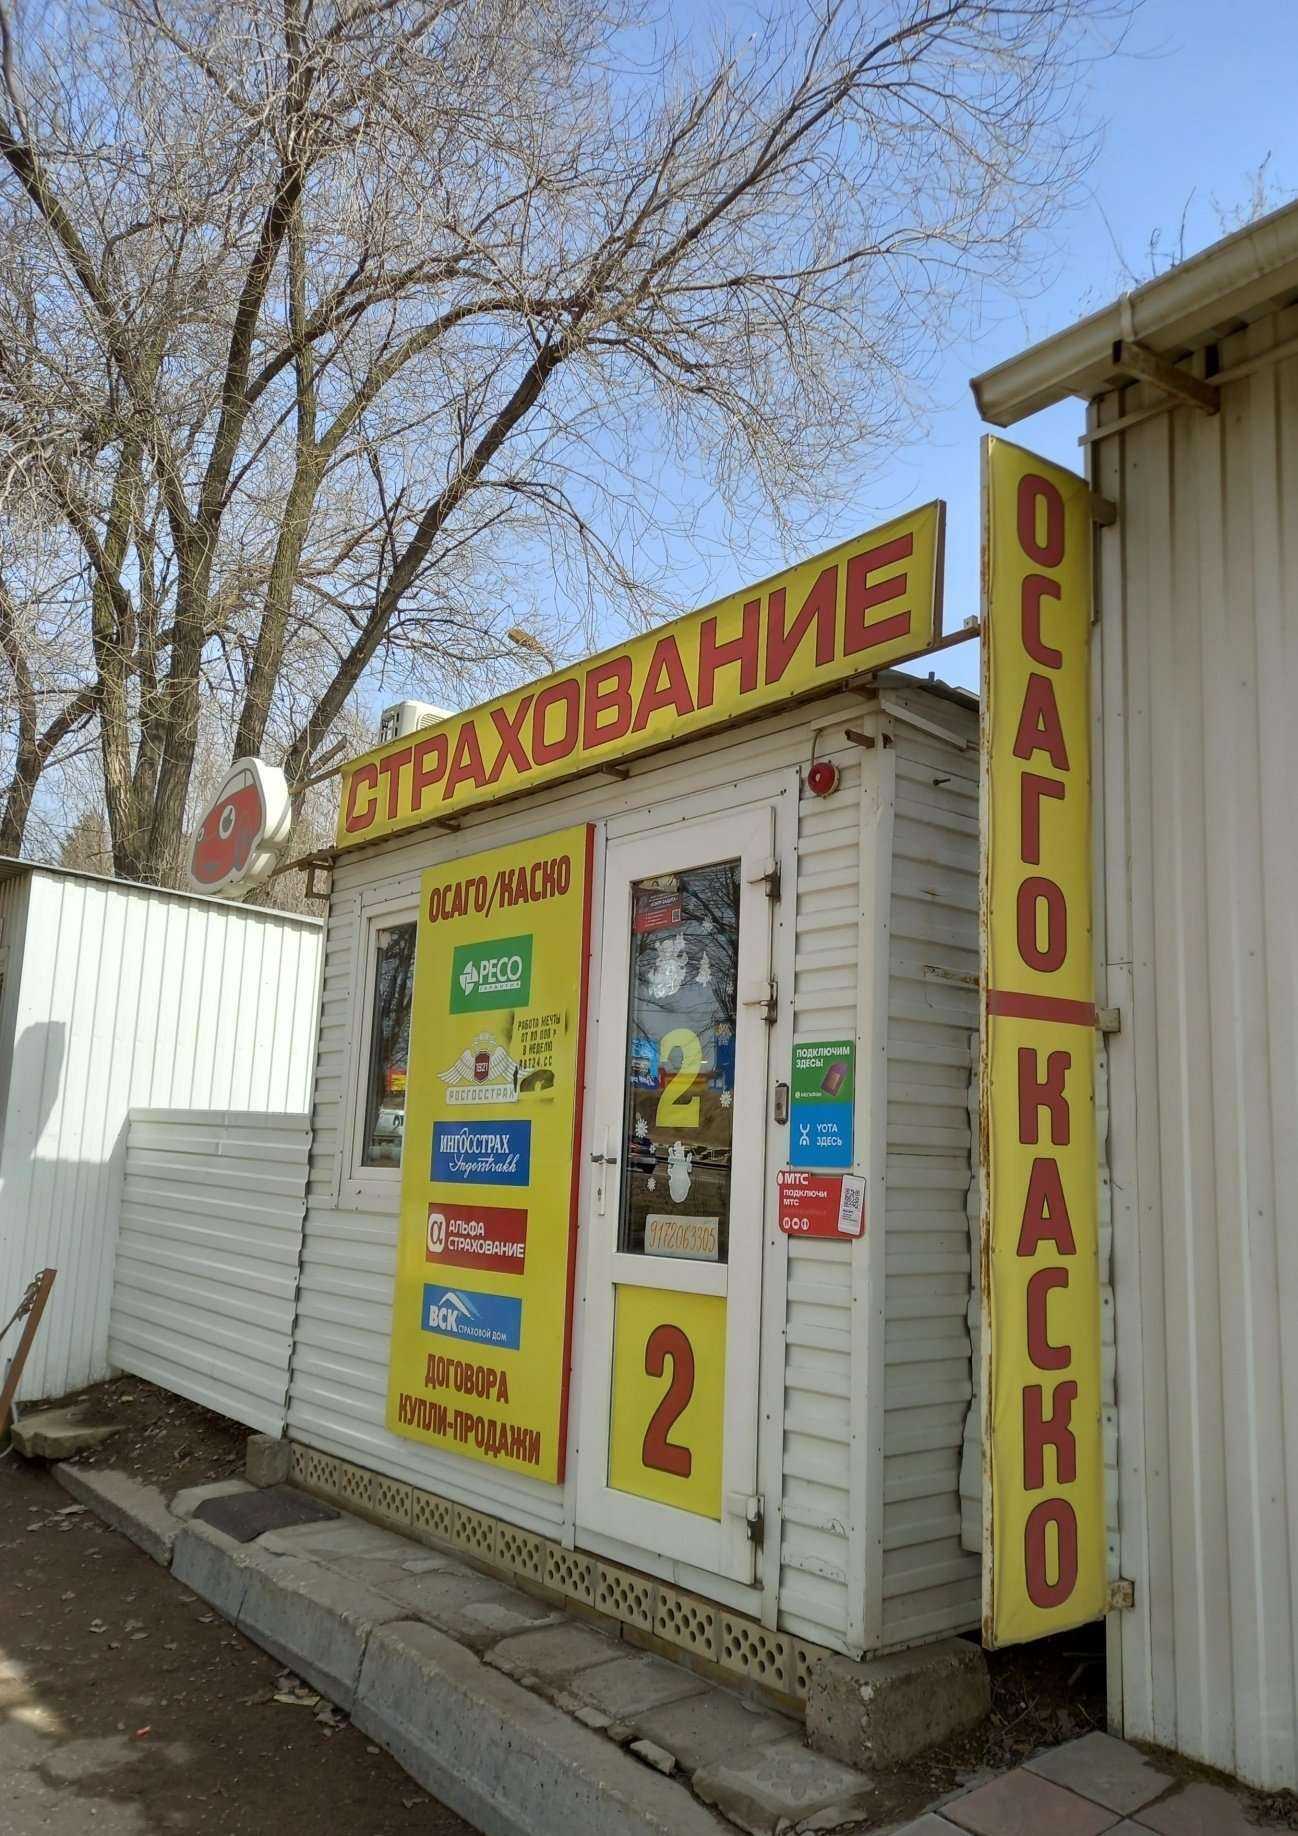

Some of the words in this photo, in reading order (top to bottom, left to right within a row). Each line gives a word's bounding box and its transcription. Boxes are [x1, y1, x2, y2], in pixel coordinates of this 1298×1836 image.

[345, 532, 914, 835] СТРАХОВАНИЕ
[1012, 473, 1070, 974] ОСАГО
[428, 855, 571, 923] ОСАГО/КАСКО
[479, 955, 523, 985] РЕСО
[540, 1013, 560, 1027] МЕЧТЫ
[796, 1046, 850, 1058] ПОДКЛЮЧИМ
[796, 1059, 824, 1070] ЗДЕСЬ!
[656, 1028, 702, 1128] 2
[448, 1087, 515, 1101] РОСГОССТРАХ
[440, 1128, 509, 1154] ИНГОССТРАХ
[816, 1123, 838, 1133] YOTA
[816, 1136, 842, 1147] ЗДЕСЬ
[784, 1173, 809, 1185] МТС
[448, 1219, 485, 1237] АЛЬФА
[448, 1236, 525, 1258] СТРАХОВАНИЕ
[429, 1305, 457, 1332] ВСК
[458, 1325, 491, 1338] СТРАХОВОЙ
[491, 1329, 507, 1342] ДОМ
[1016, 1046, 1077, 1609] КАСКО
[424, 1353, 509, 1404] ДОГОВОРА
[642, 1324, 695, 1479] 2
[398, 1393, 541, 1466] КУПЛИ-ПРОДАЖИ
